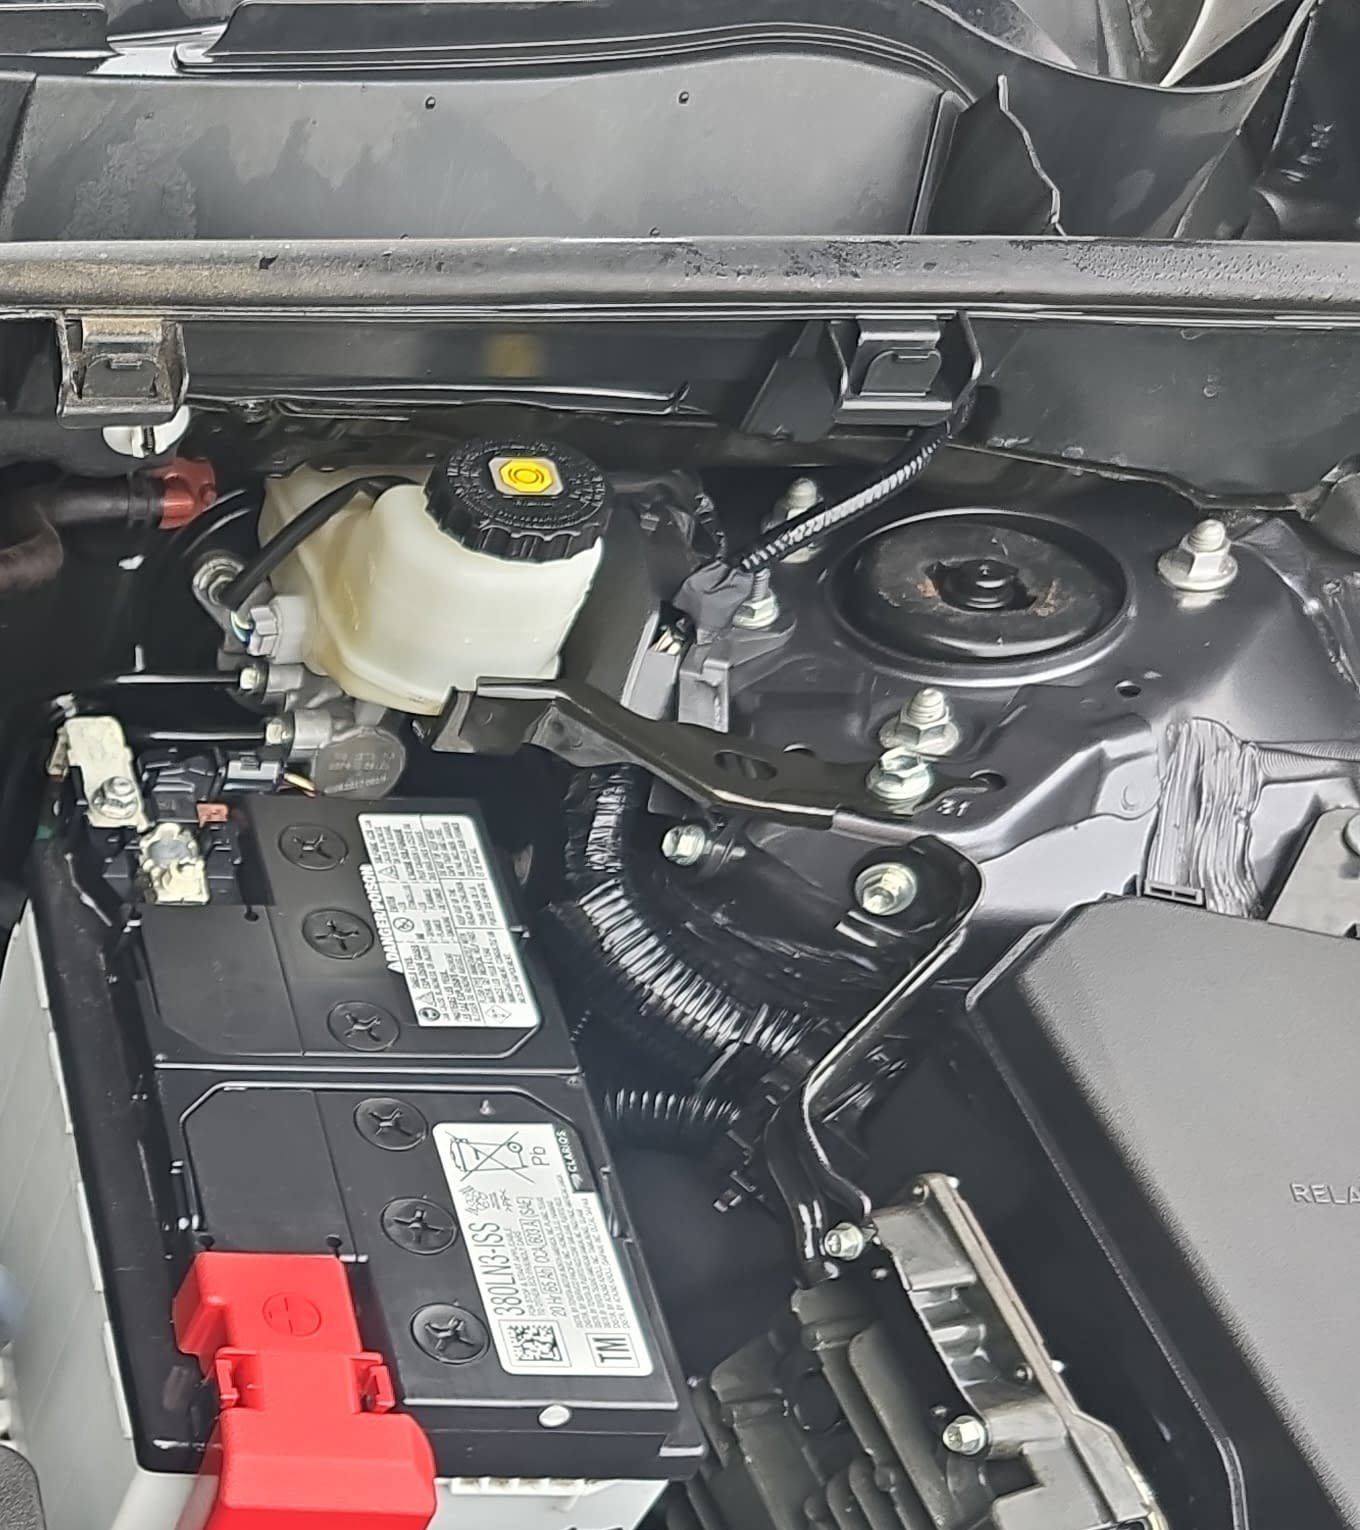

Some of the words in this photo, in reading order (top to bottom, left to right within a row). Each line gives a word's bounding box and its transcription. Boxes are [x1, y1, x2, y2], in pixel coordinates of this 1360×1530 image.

[360, 864, 399, 961] DANGER/POISON
[530, 1144, 552, 1167] Pb
[555, 1129, 579, 1172] CLARIOS
[467, 1222, 526, 1315] 380LN3-ISS
[592, 1337, 633, 1363] TM
